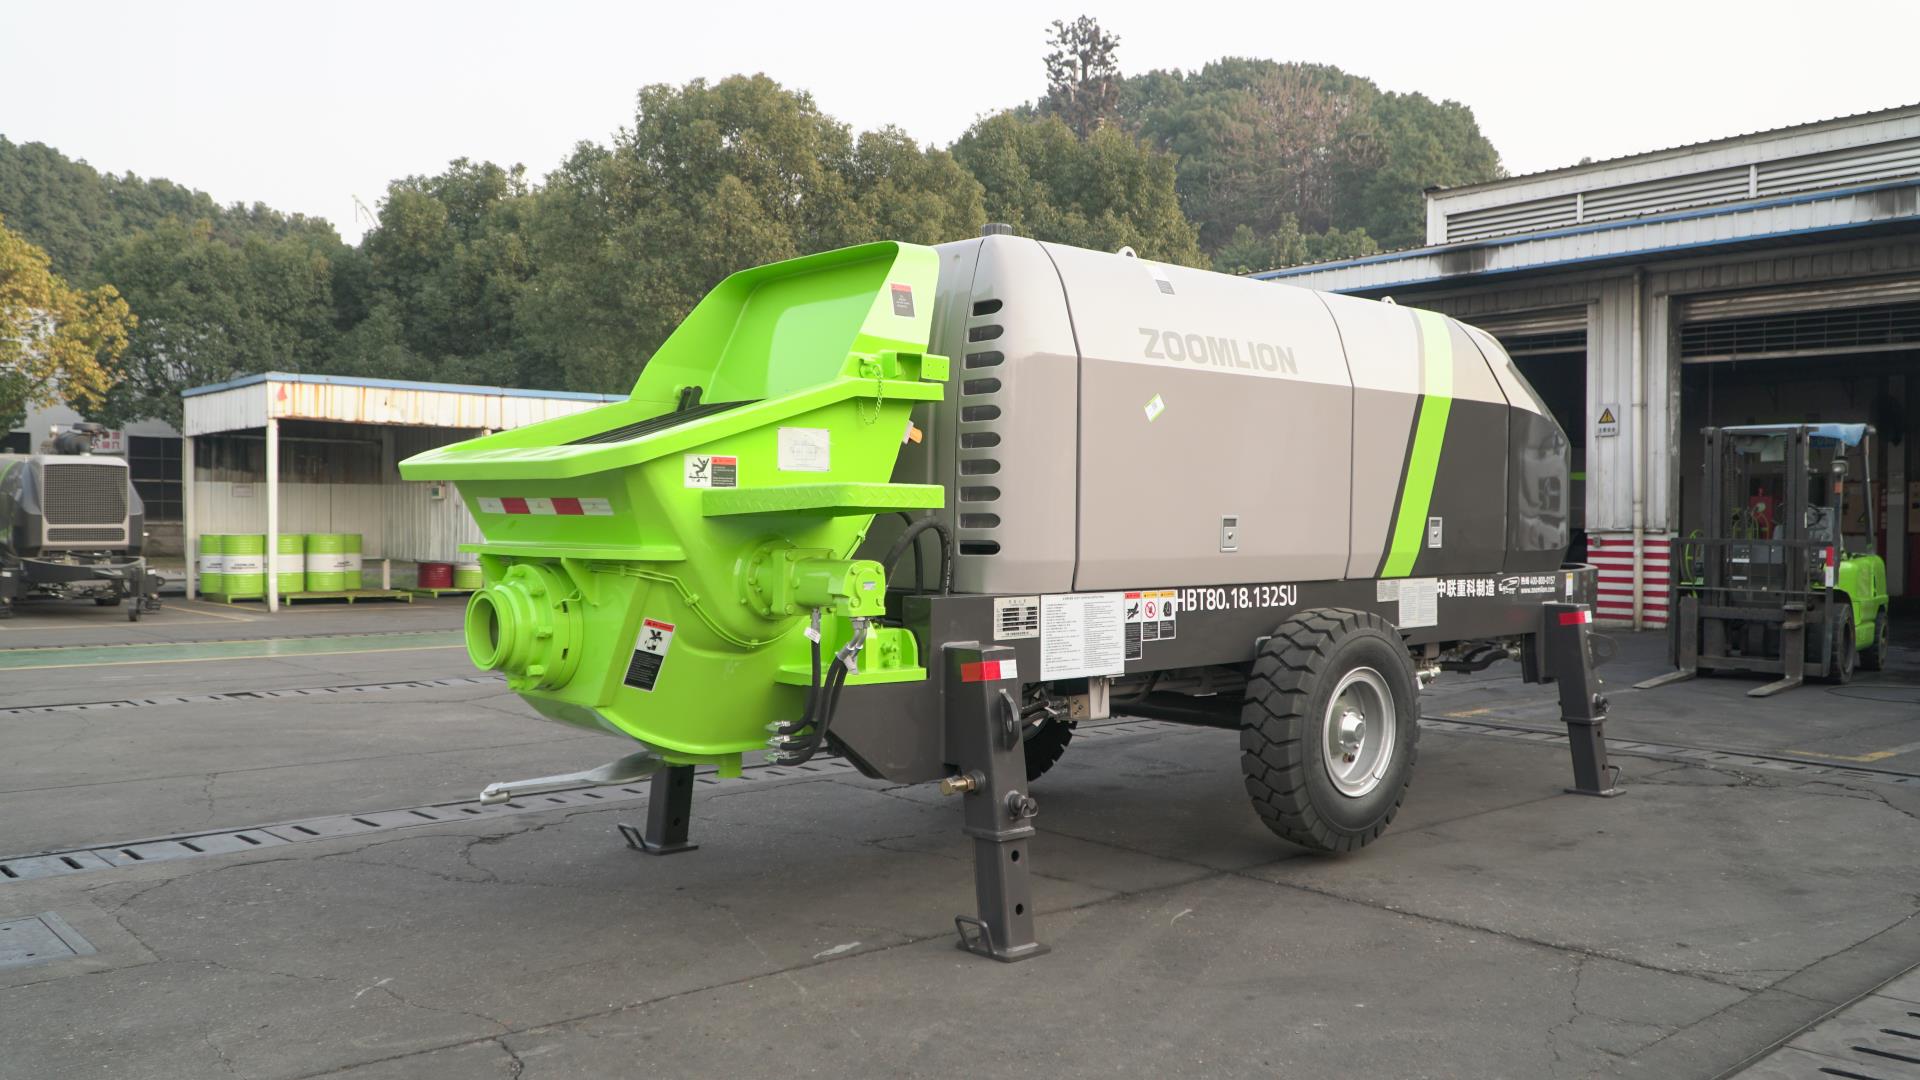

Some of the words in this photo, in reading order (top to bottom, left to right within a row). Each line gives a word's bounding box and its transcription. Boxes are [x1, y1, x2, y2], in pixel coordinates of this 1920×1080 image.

[1138, 327, 1298, 374] ZOOMLION
[1176, 585, 1297, 612] HBT80.18.132SU
[1437, 578, 1495, 598] 中联重科制造
